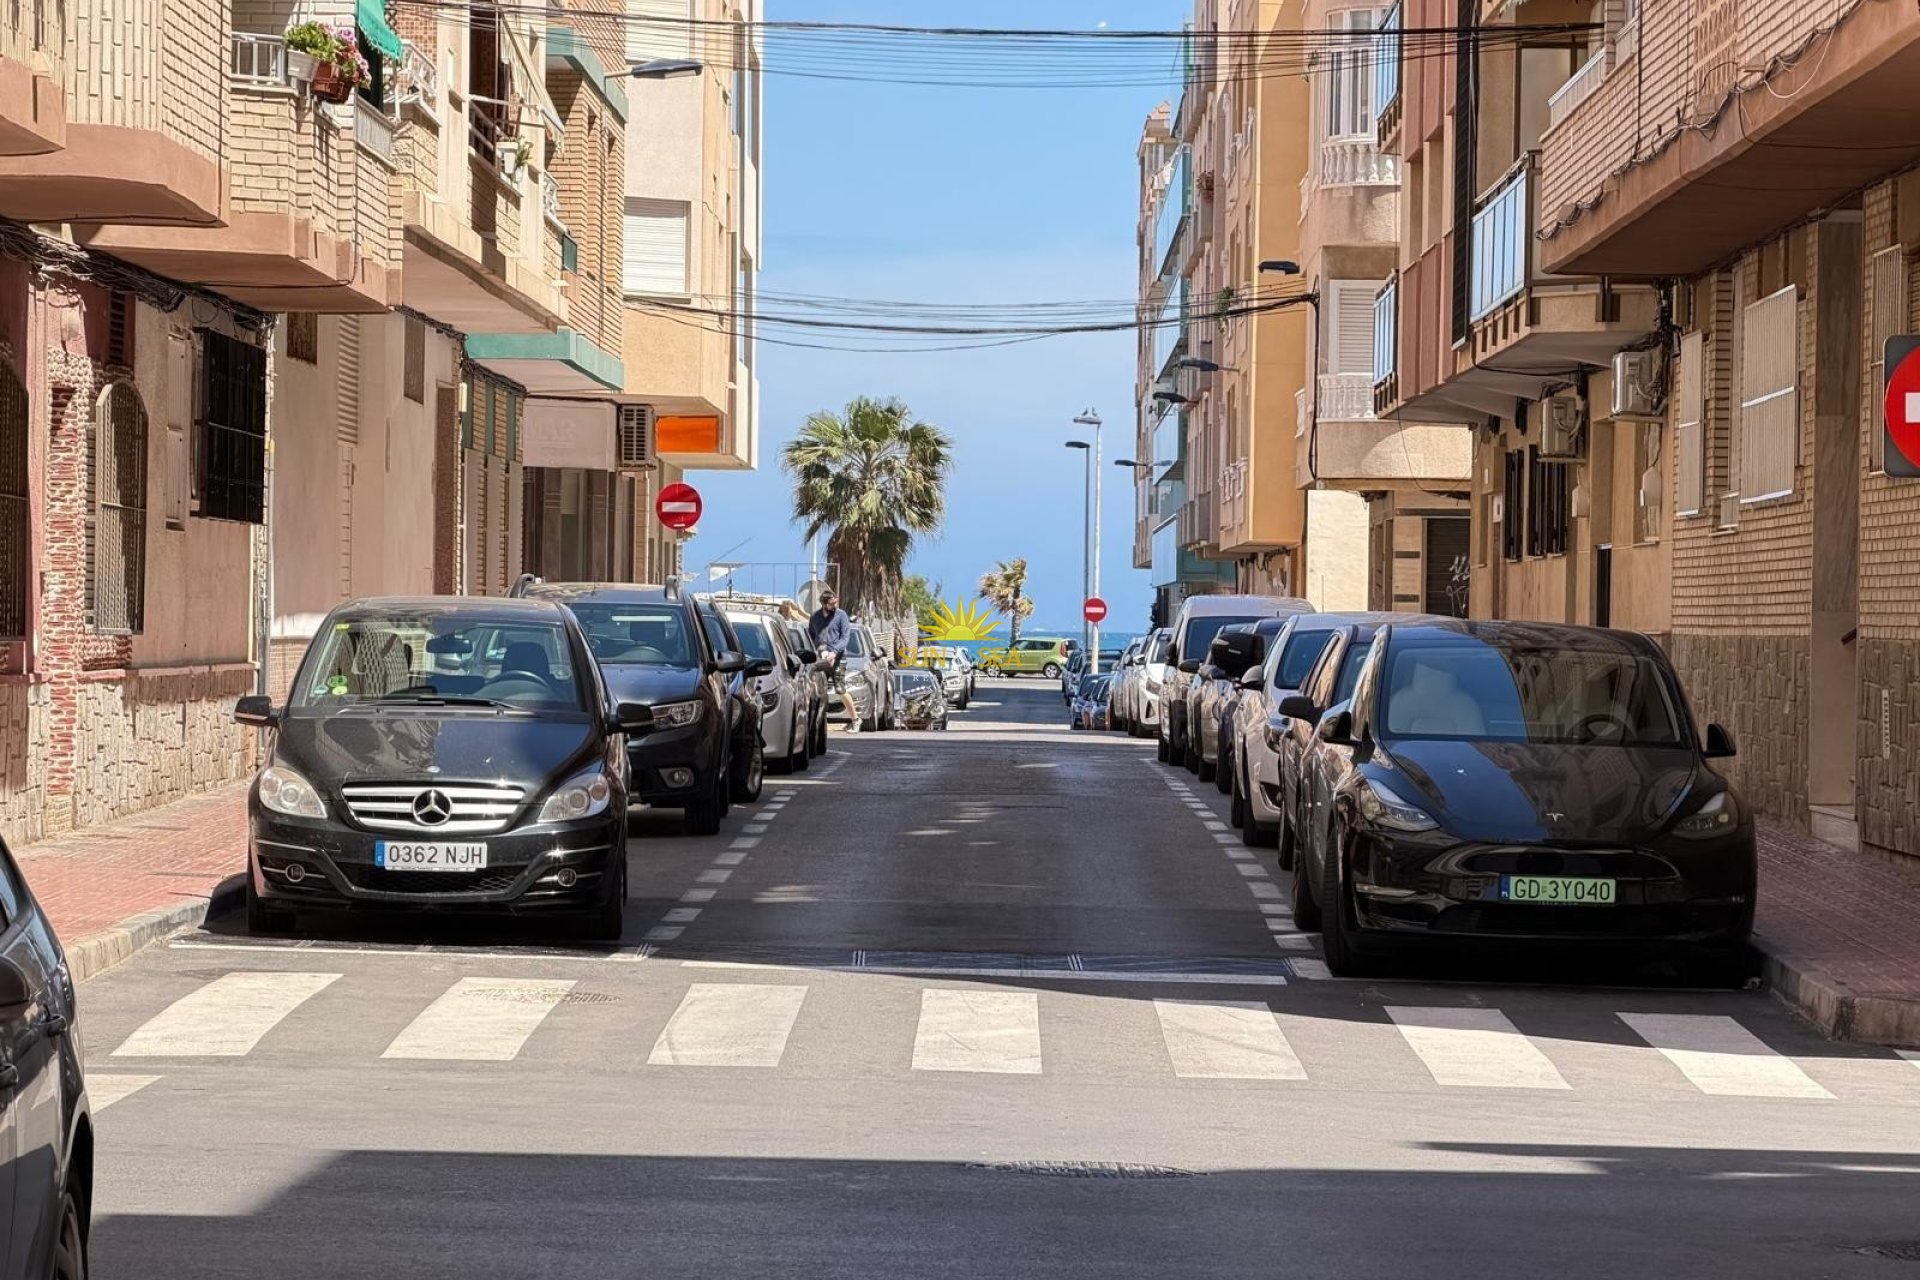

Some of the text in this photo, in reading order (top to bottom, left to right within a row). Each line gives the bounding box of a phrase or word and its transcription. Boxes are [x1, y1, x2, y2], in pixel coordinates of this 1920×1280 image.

[389, 845, 482, 863] 0362 NJH
[1514, 878, 1540, 899] GD
